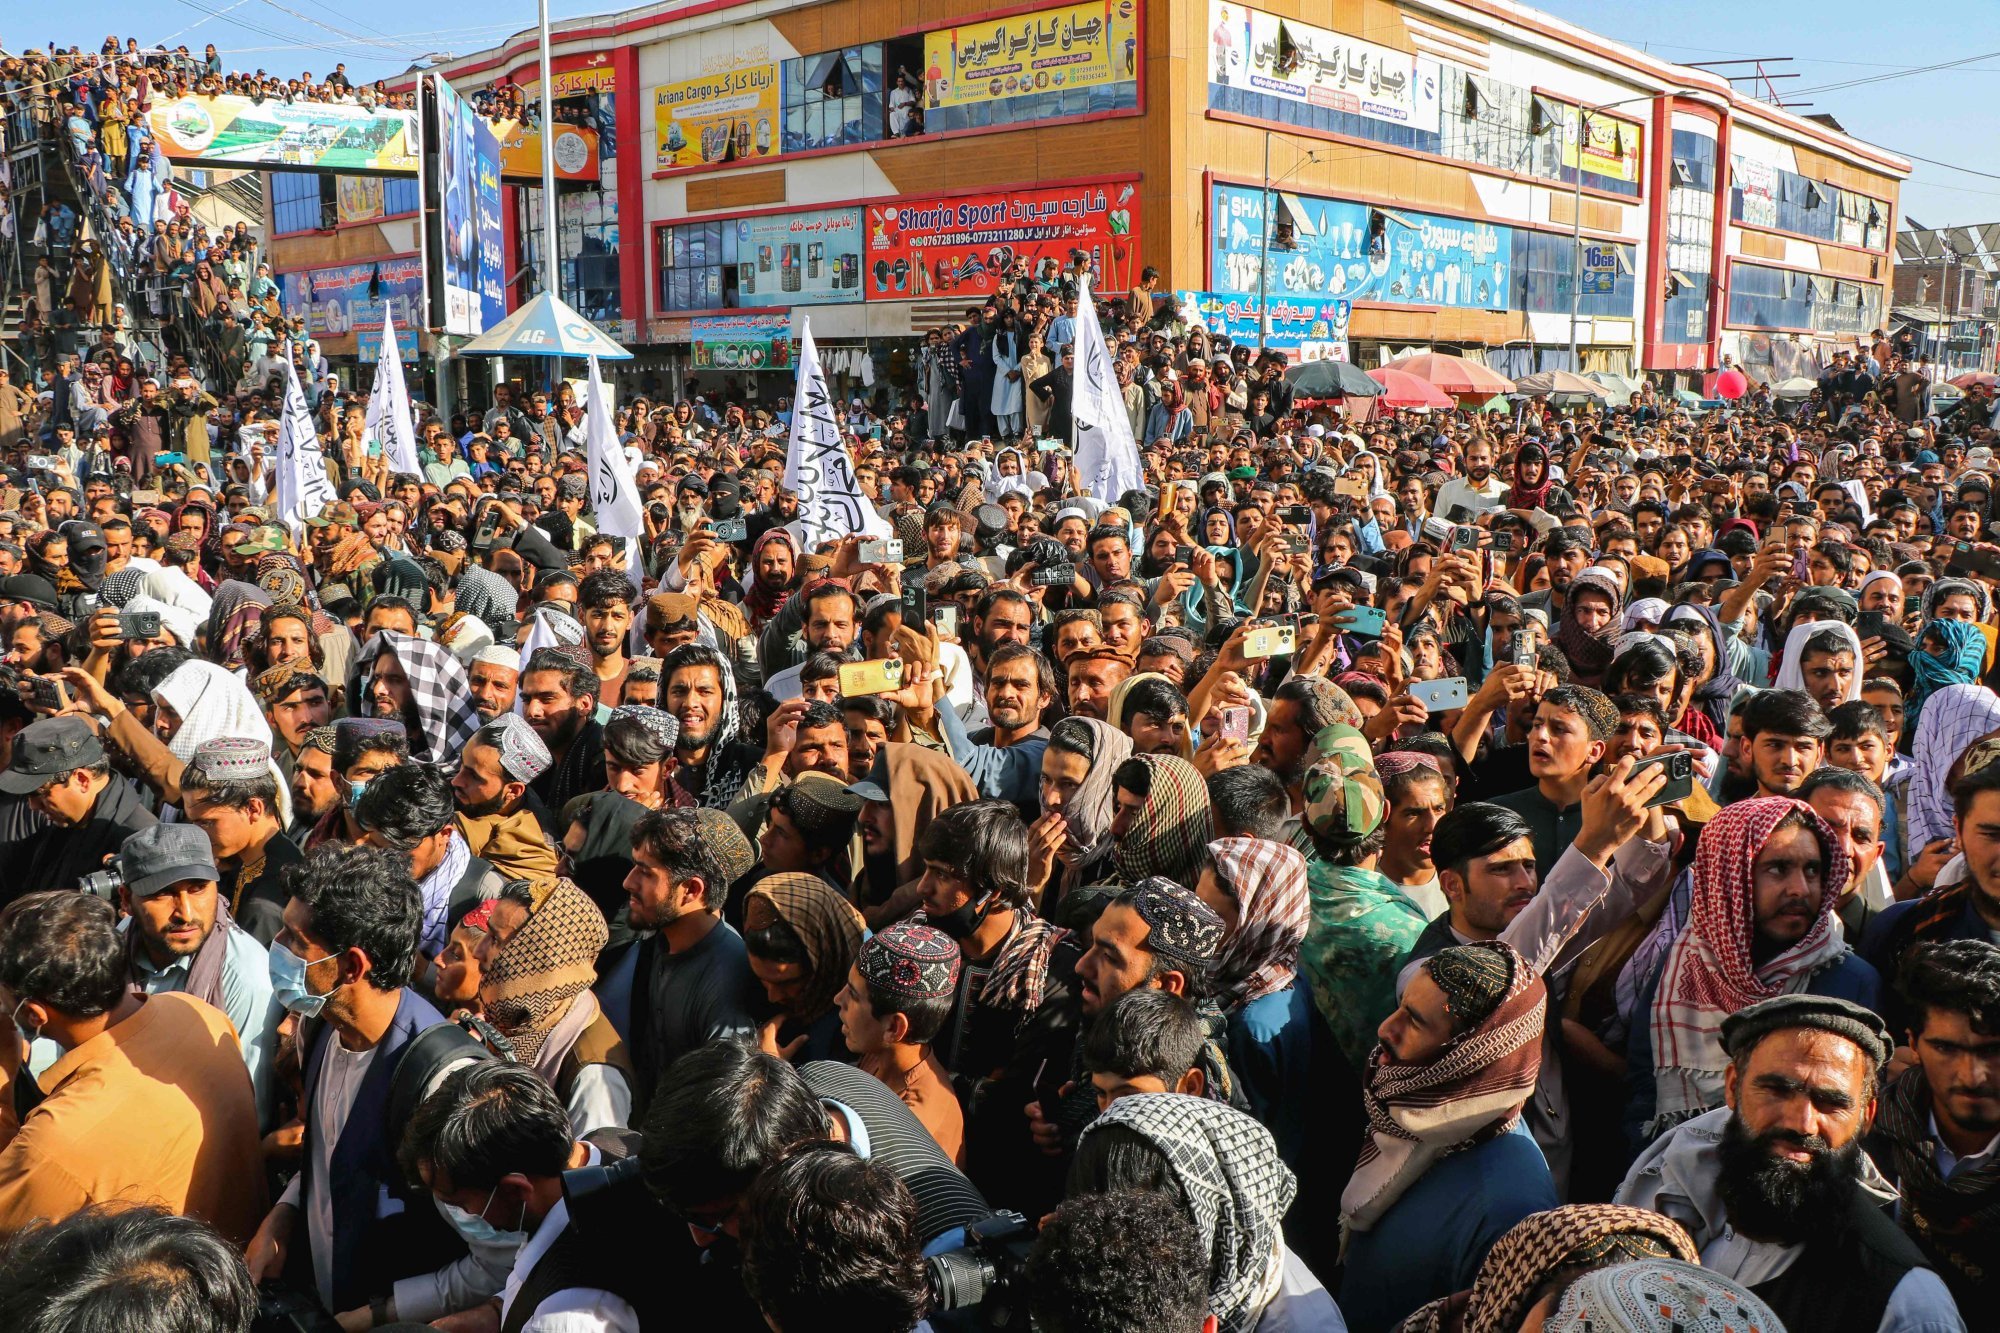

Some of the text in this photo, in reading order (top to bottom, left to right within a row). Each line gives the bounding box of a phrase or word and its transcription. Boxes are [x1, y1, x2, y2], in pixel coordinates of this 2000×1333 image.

[658, 90, 684, 106] Ariana
[686, 85, 712, 100] Cargo
[1061, 190, 1107, 218] شارجه
[899, 201, 1007, 233] Sharja Sport
[516, 329, 546, 344] 4G
